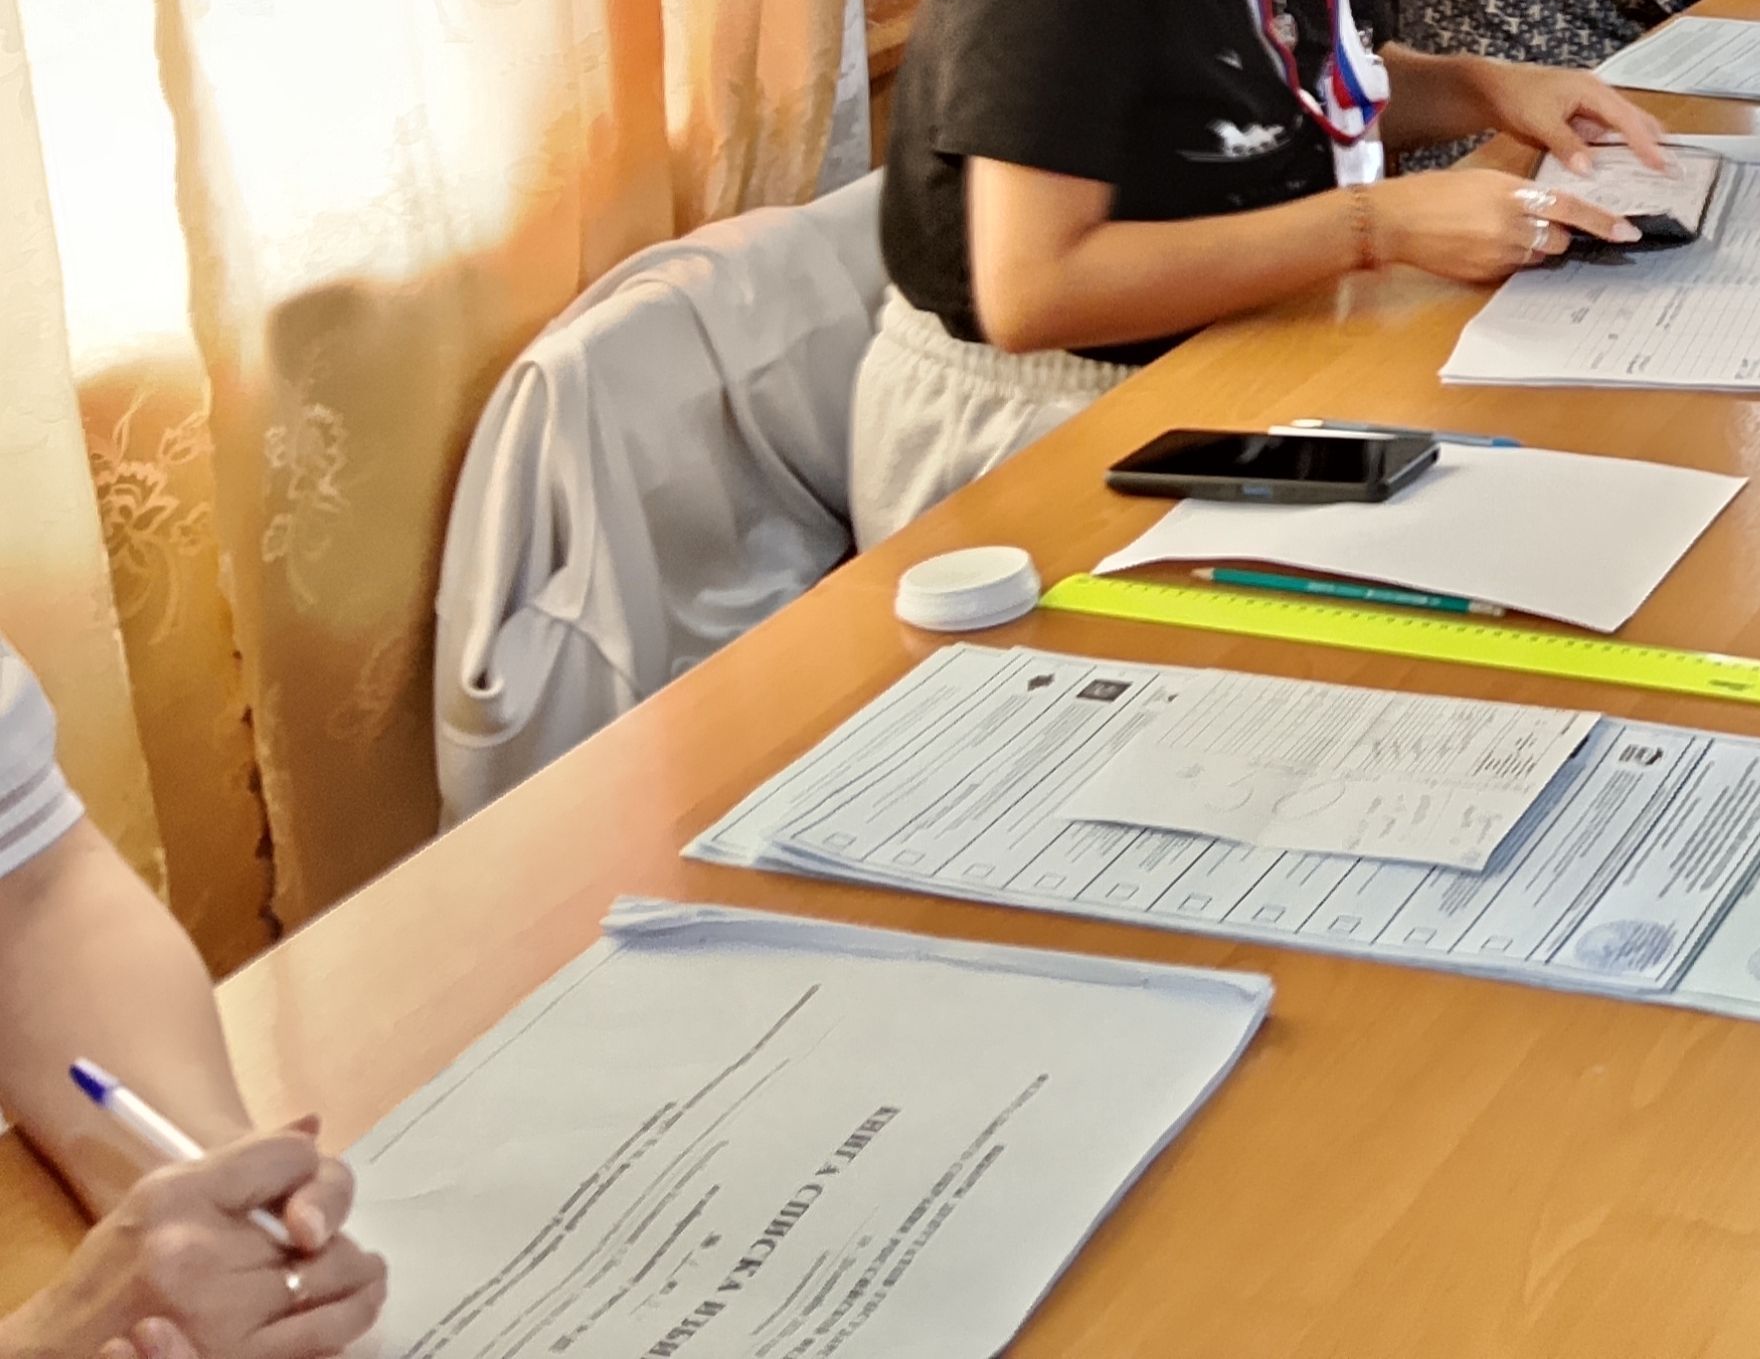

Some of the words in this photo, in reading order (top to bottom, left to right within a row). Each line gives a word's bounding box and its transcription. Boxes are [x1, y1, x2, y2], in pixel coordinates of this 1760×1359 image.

[815, 1106, 901, 1176] КНИГА
[717, 1184, 824, 1291] СПИСКА
[638, 1301, 727, 1359] ИЗБИ
